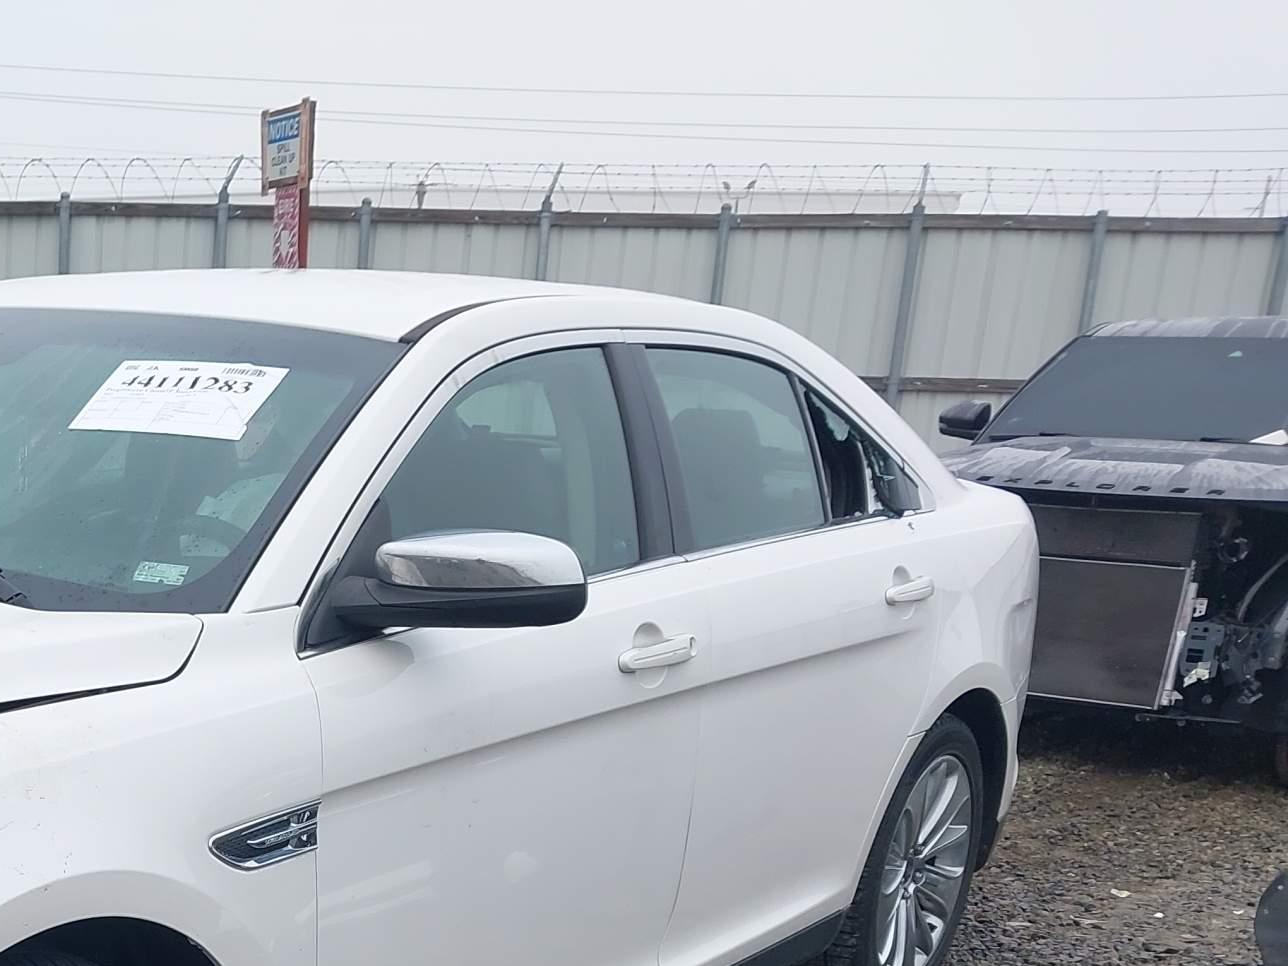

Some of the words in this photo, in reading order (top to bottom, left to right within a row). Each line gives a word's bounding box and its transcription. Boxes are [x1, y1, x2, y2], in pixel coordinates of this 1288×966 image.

[270, 117, 299, 140] NOTICE
[121, 374, 253, 393] 44111283
[975, 475, 1226, 496] EXPLORER
